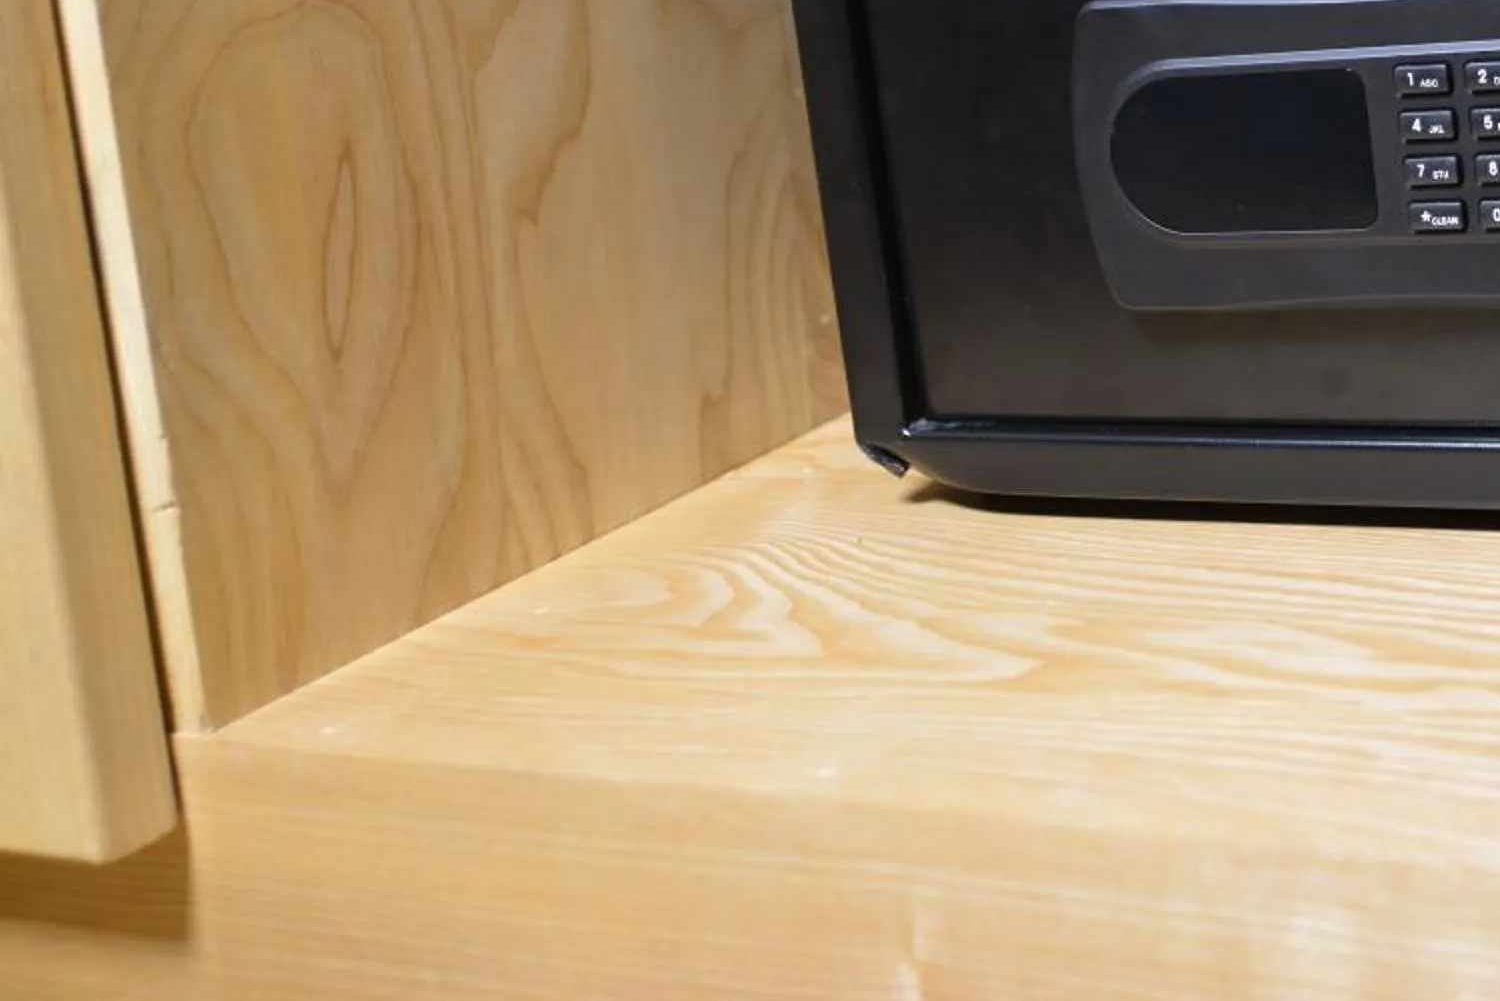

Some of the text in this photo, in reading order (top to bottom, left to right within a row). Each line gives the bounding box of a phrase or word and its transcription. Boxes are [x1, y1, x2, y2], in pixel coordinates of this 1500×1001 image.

[1407, 73, 1439, 88] 1 ABC
[1477, 69, 1488, 84] 2
[1411, 118, 1421, 132] 4
[1483, 115, 1493, 130] 5
[1416, 164, 1426, 178] 7
[1488, 161, 1498, 176] 8
